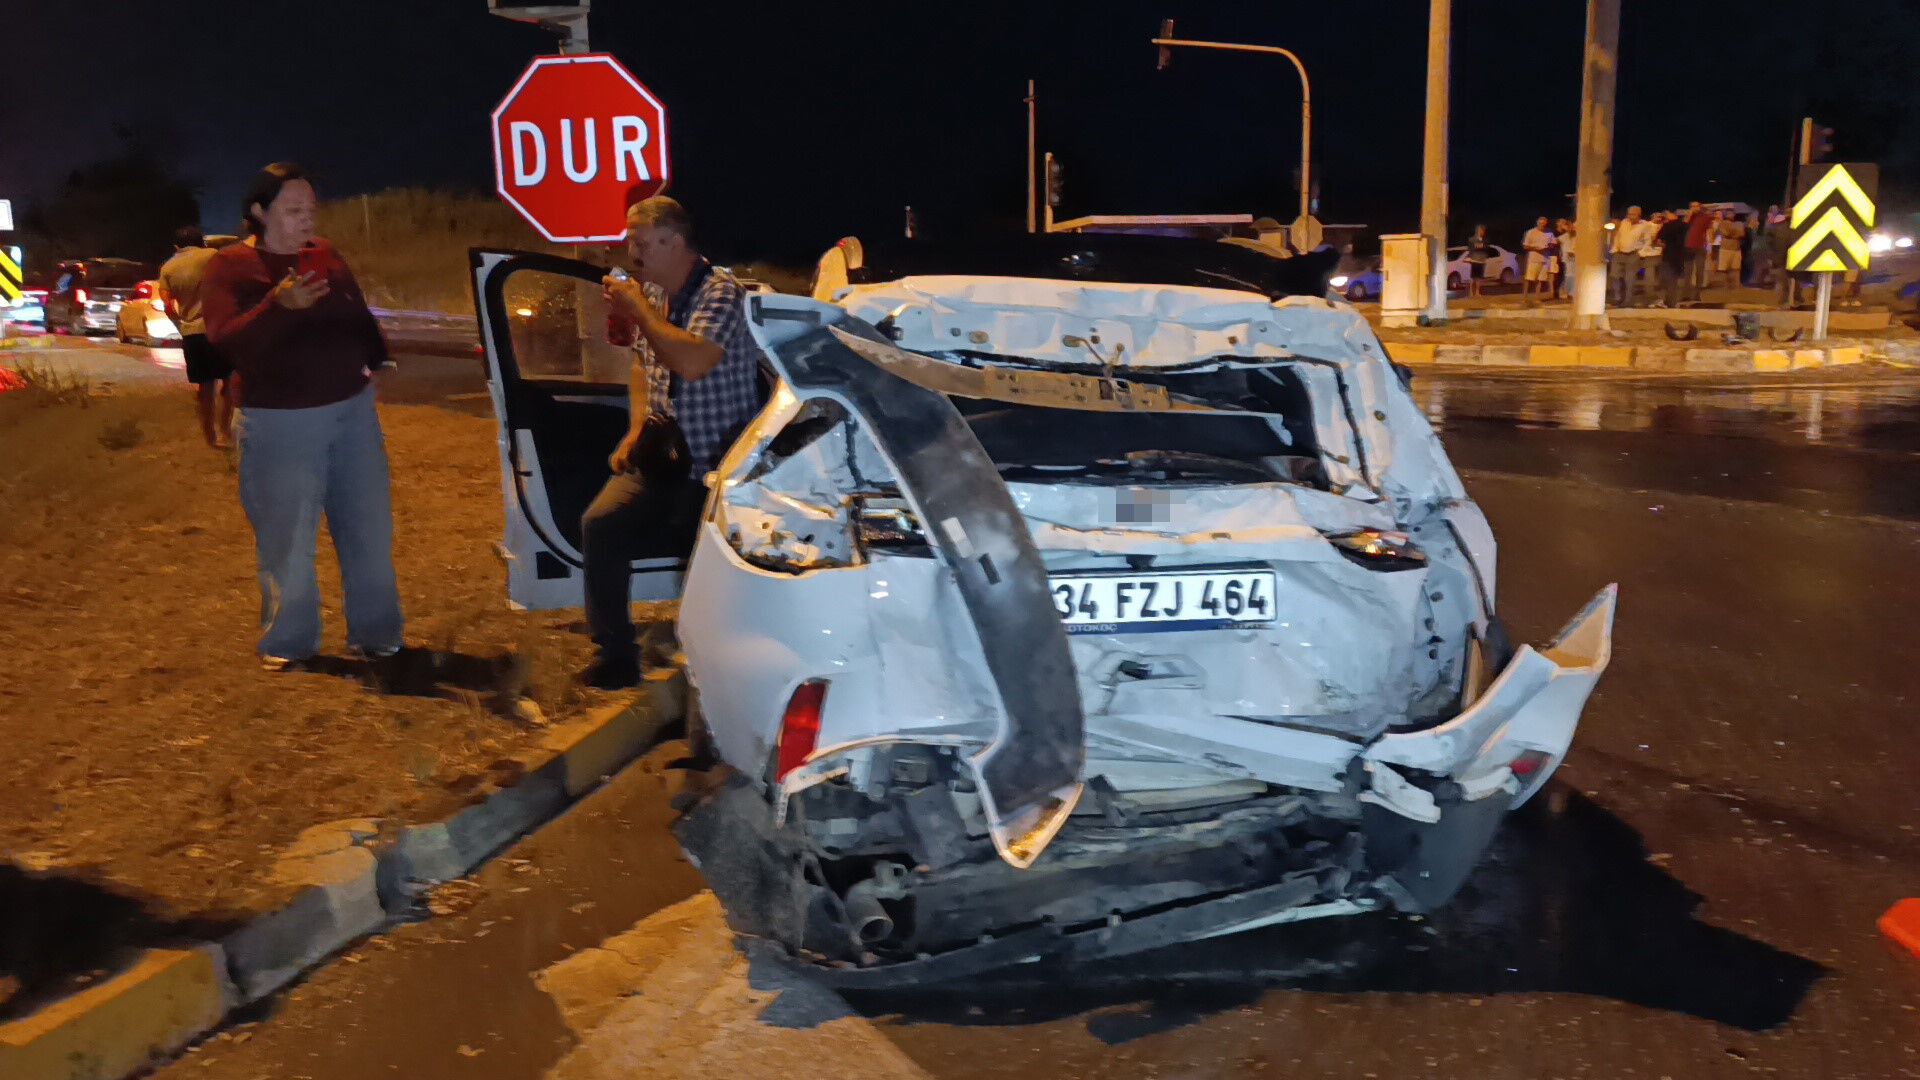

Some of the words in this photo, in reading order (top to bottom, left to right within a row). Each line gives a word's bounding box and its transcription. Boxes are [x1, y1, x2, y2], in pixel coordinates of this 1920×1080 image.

[510, 116, 650, 186] DUR
[1054, 583, 1099, 619] 34
[1117, 581, 1184, 618] FZJ
[1201, 578, 1269, 616] 464
